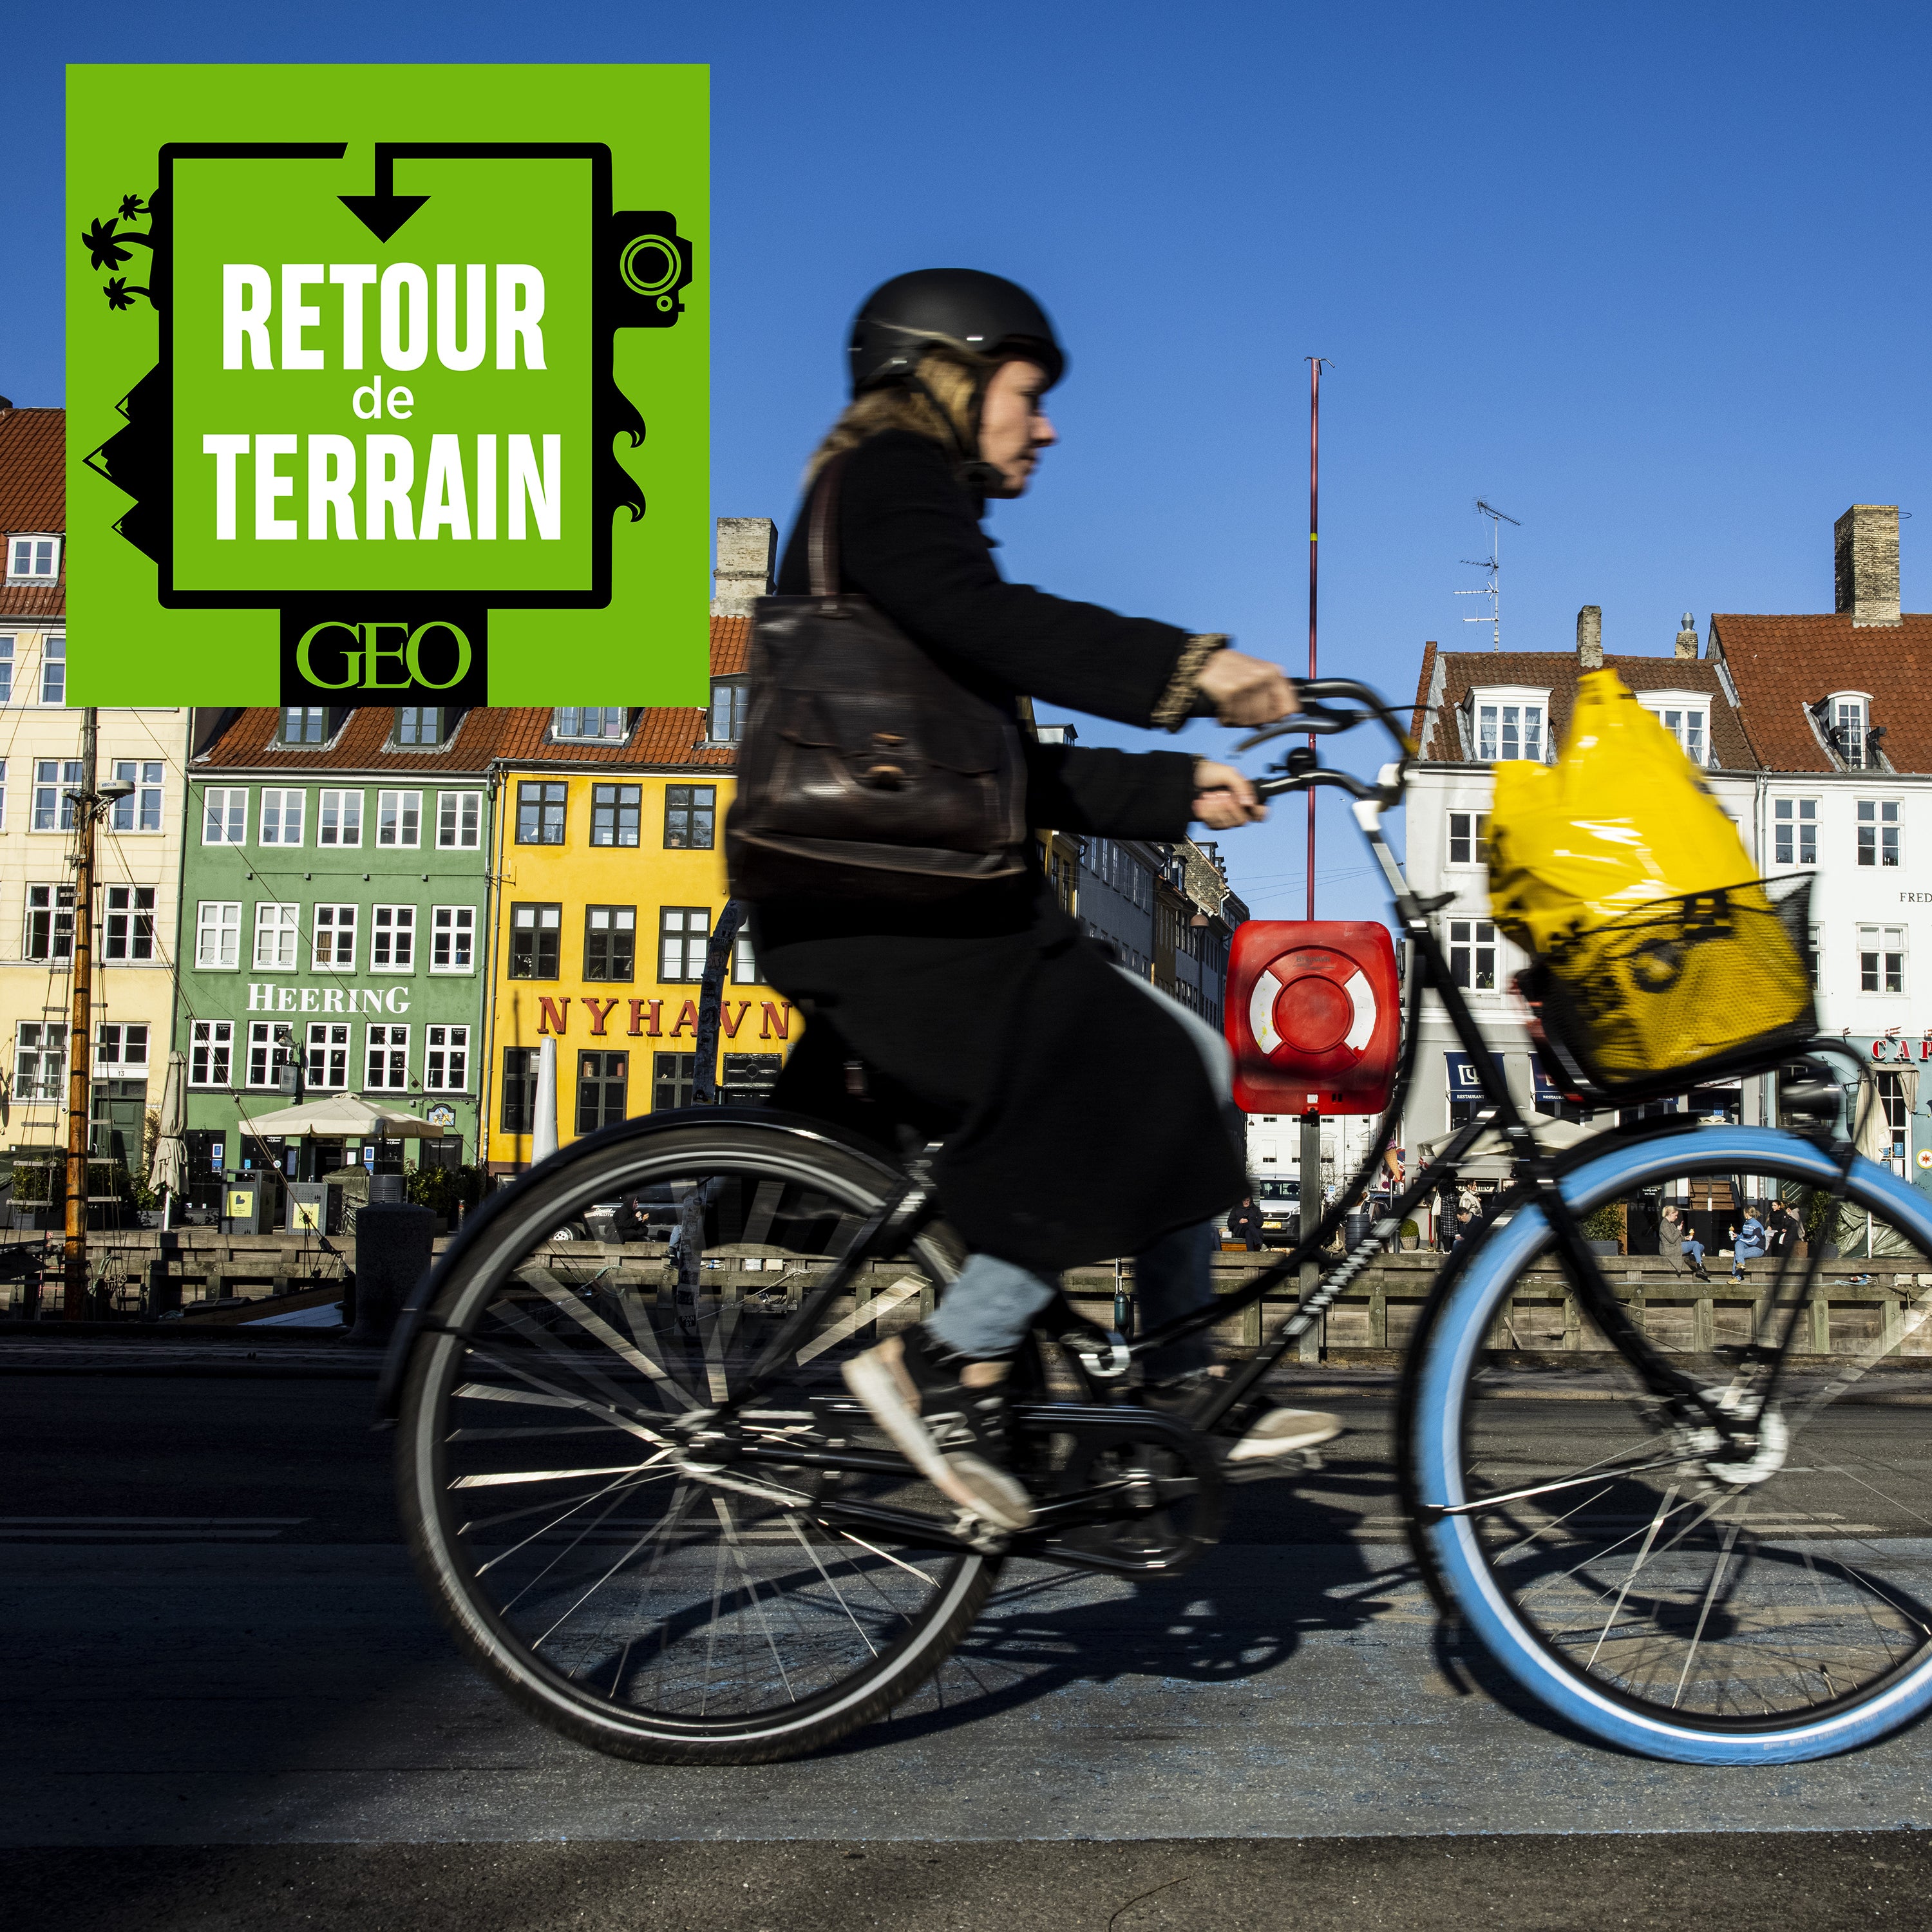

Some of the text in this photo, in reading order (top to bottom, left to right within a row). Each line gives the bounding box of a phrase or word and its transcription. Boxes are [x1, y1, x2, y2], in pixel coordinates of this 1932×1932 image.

[1900, 893, 1932, 902] FRED
[247, 983, 411, 1014] HEERING
[536, 997, 792, 1039] NYHAVN
